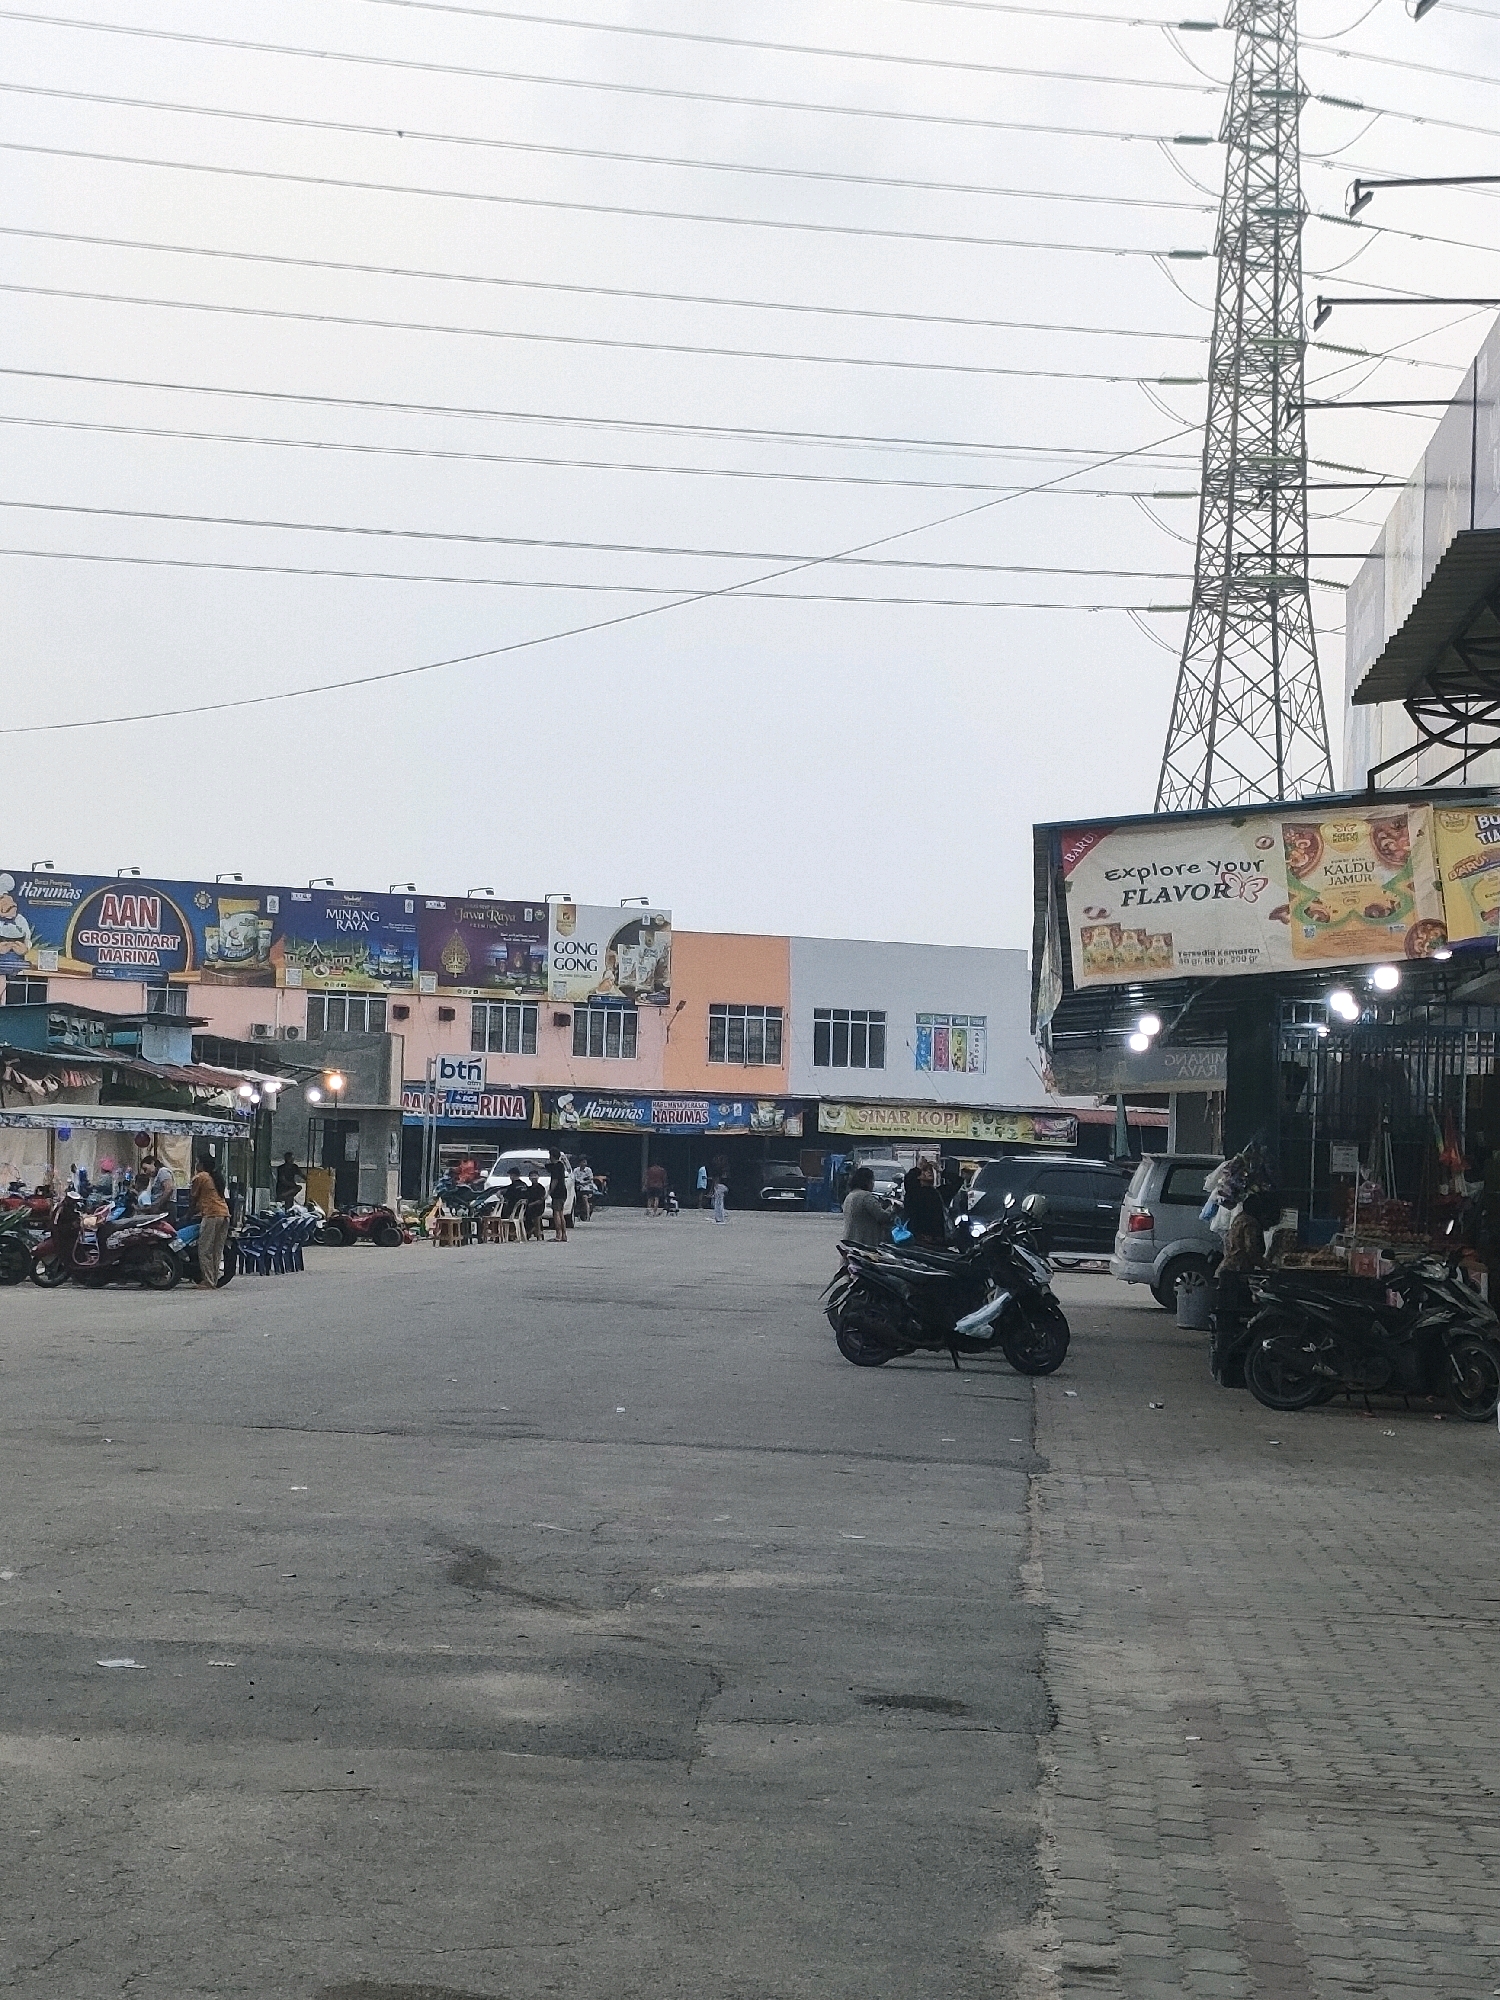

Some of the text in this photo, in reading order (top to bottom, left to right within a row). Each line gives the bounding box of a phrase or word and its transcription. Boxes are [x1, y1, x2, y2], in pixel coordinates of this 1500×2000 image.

[1104, 858, 1265, 884] Explore Your
[1323, 861, 1376, 876] KALDU
[1327, 873, 1374, 886] JAMUR
[18, 881, 83, 900] Harumas
[1120, 883, 1233, 907] FLAVOR
[99, 893, 161, 930] AAN
[325, 908, 380, 922] MINANG
[454, 907, 516, 926] Jawa Raya
[336, 920, 370, 932] RAYA
[78, 930, 181, 950] GROSIR MART
[553, 941, 598, 955] GONG
[99, 948, 160, 965] MARINA
[553, 957, 598, 971] GONG
[582, 1101, 645, 1120] Harumas
[652, 1109, 709, 1124] HARUMAS
[858, 1110, 960, 1126] SINAR KOPI
